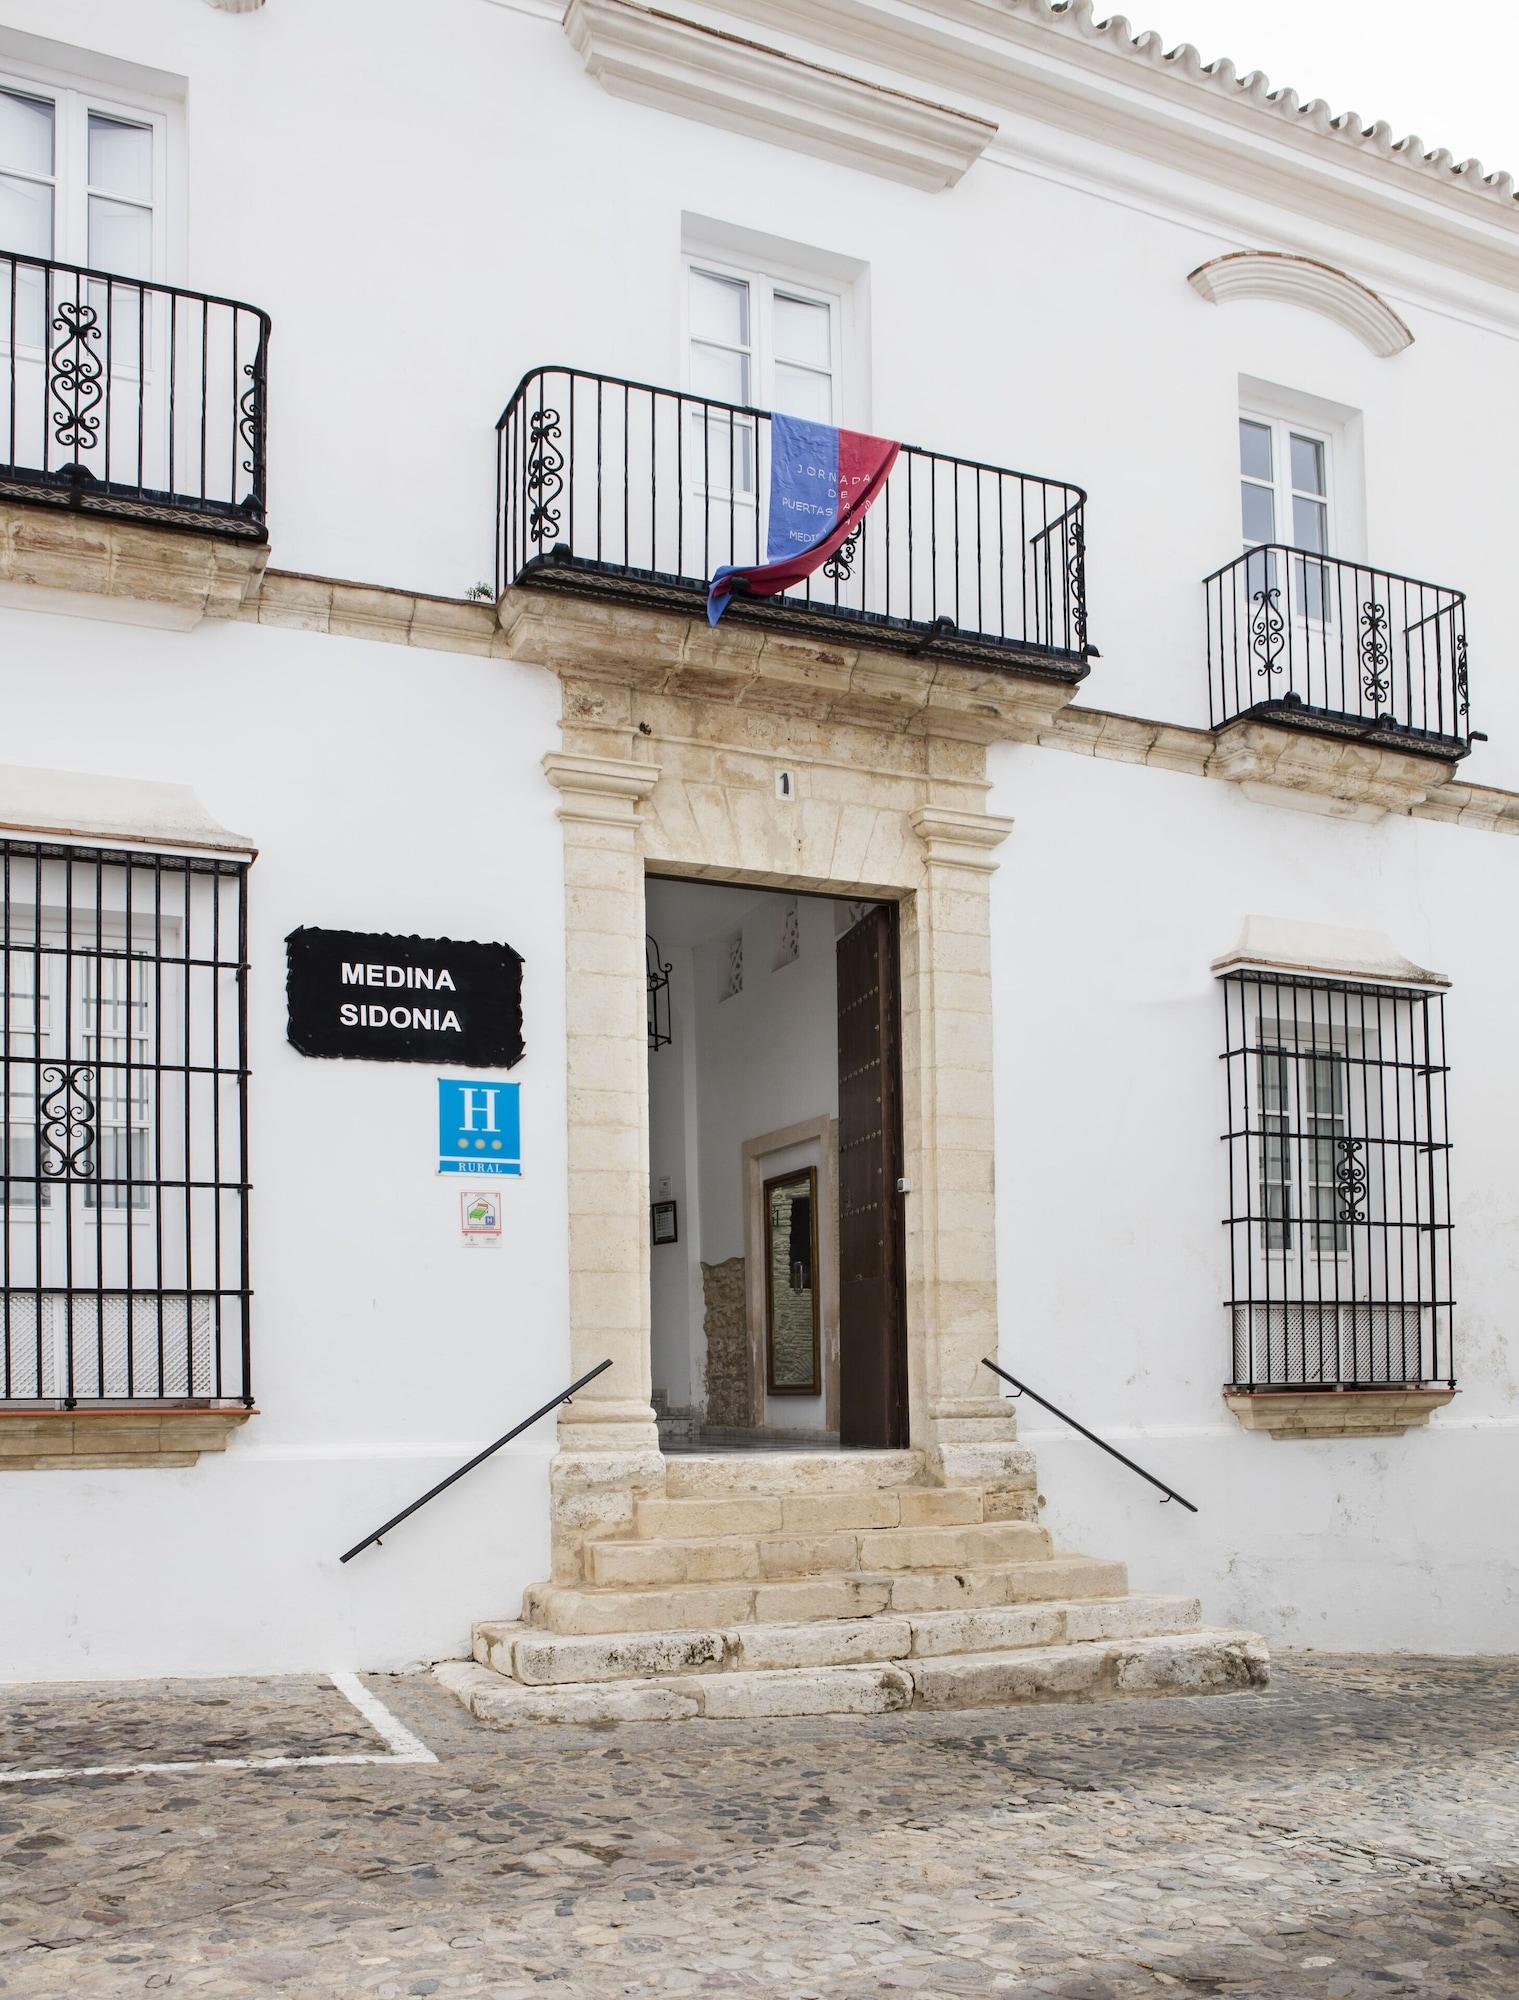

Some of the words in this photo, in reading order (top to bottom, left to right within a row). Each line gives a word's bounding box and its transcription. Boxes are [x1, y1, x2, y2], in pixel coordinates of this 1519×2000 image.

[797, 464, 871, 485] JORNADA
[827, 488, 848, 499] DE
[782, 497, 833, 516] PUERTAS
[779, 772, 790, 795] 1
[341, 962, 457, 991] MEDINA
[339, 1003, 463, 1032] SIDONIA
[458, 1087, 501, 1132] H
[458, 1162, 503, 1173] RURAL
